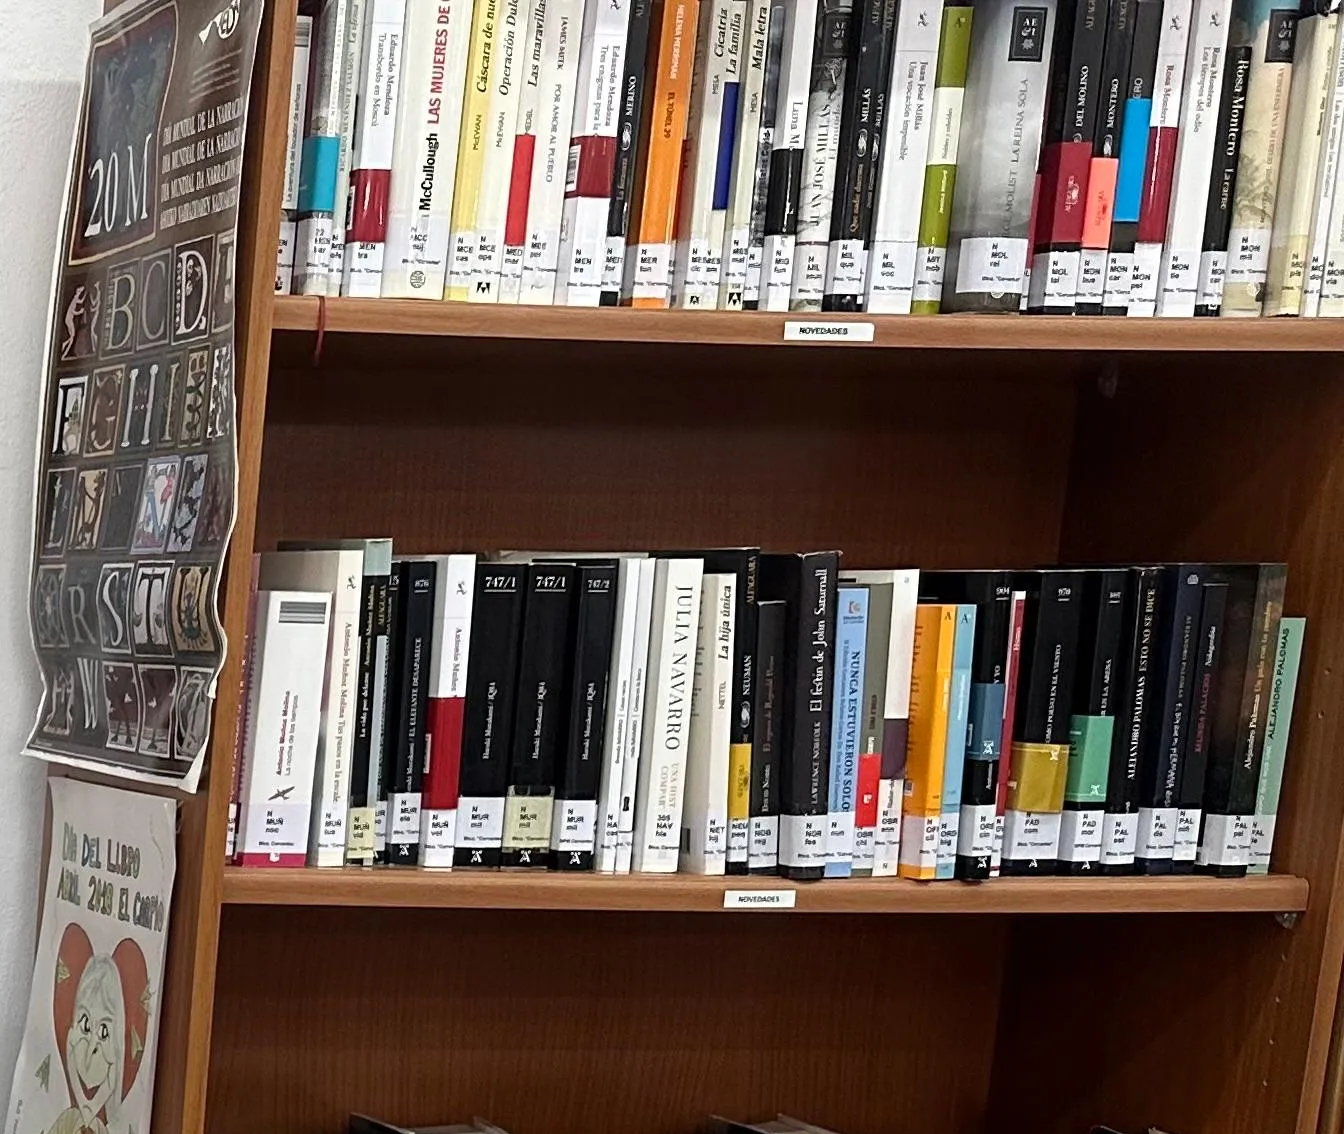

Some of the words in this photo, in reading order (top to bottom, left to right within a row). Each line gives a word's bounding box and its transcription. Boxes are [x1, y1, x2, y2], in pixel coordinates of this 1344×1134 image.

[728, 12, 742, 51] familia
[755, 6, 767, 34] letra
[432, 23, 448, 90] MUJERES
[476, 43, 492, 93] Cáscara
[499, 38, 515, 96] Operación
[751, 36, 765, 70] Mala
[1234, 60, 1248, 90] Rosa
[427, 93, 441, 124] LAS
[1226, 93, 1243, 156] Montero
[84, 151, 119, 236] 20
[125, 132, 152, 226] M
[671, 586, 693, 642] JULIA
[719, 613, 731, 640] hija
[664, 650, 689, 751] NAVARRO
